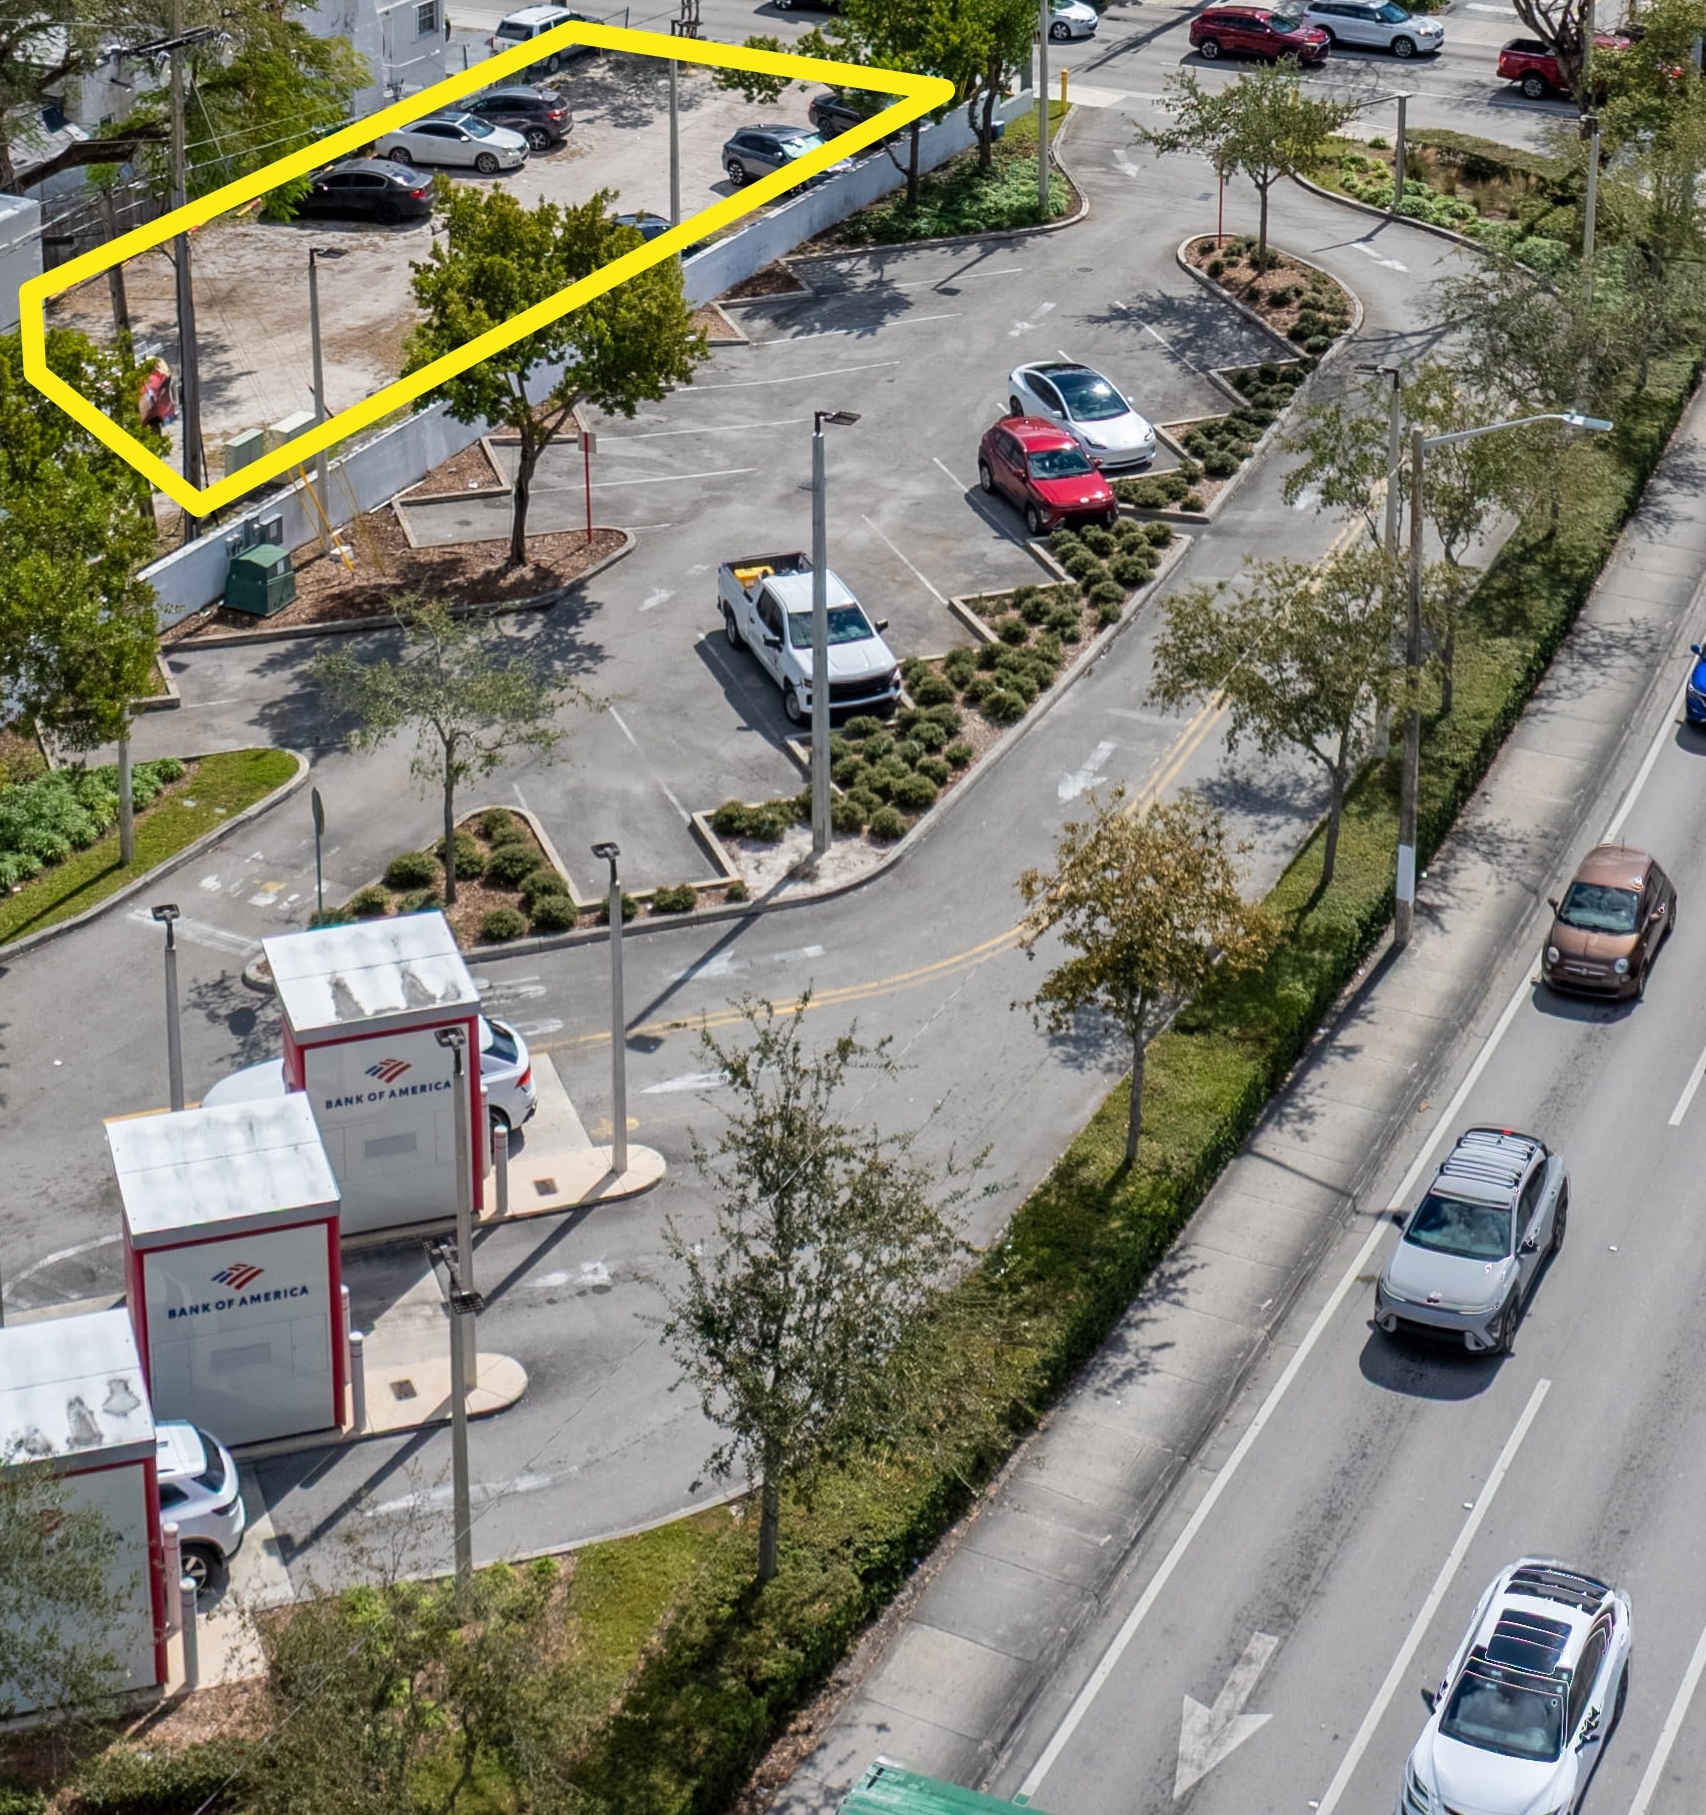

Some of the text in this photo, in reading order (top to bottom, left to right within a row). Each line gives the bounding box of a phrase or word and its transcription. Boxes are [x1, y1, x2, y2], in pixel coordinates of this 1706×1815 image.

[325, 1080, 452, 1109] BANK OF AMERICA
[168, 1285, 309, 1319] BANK OF AMERICA
